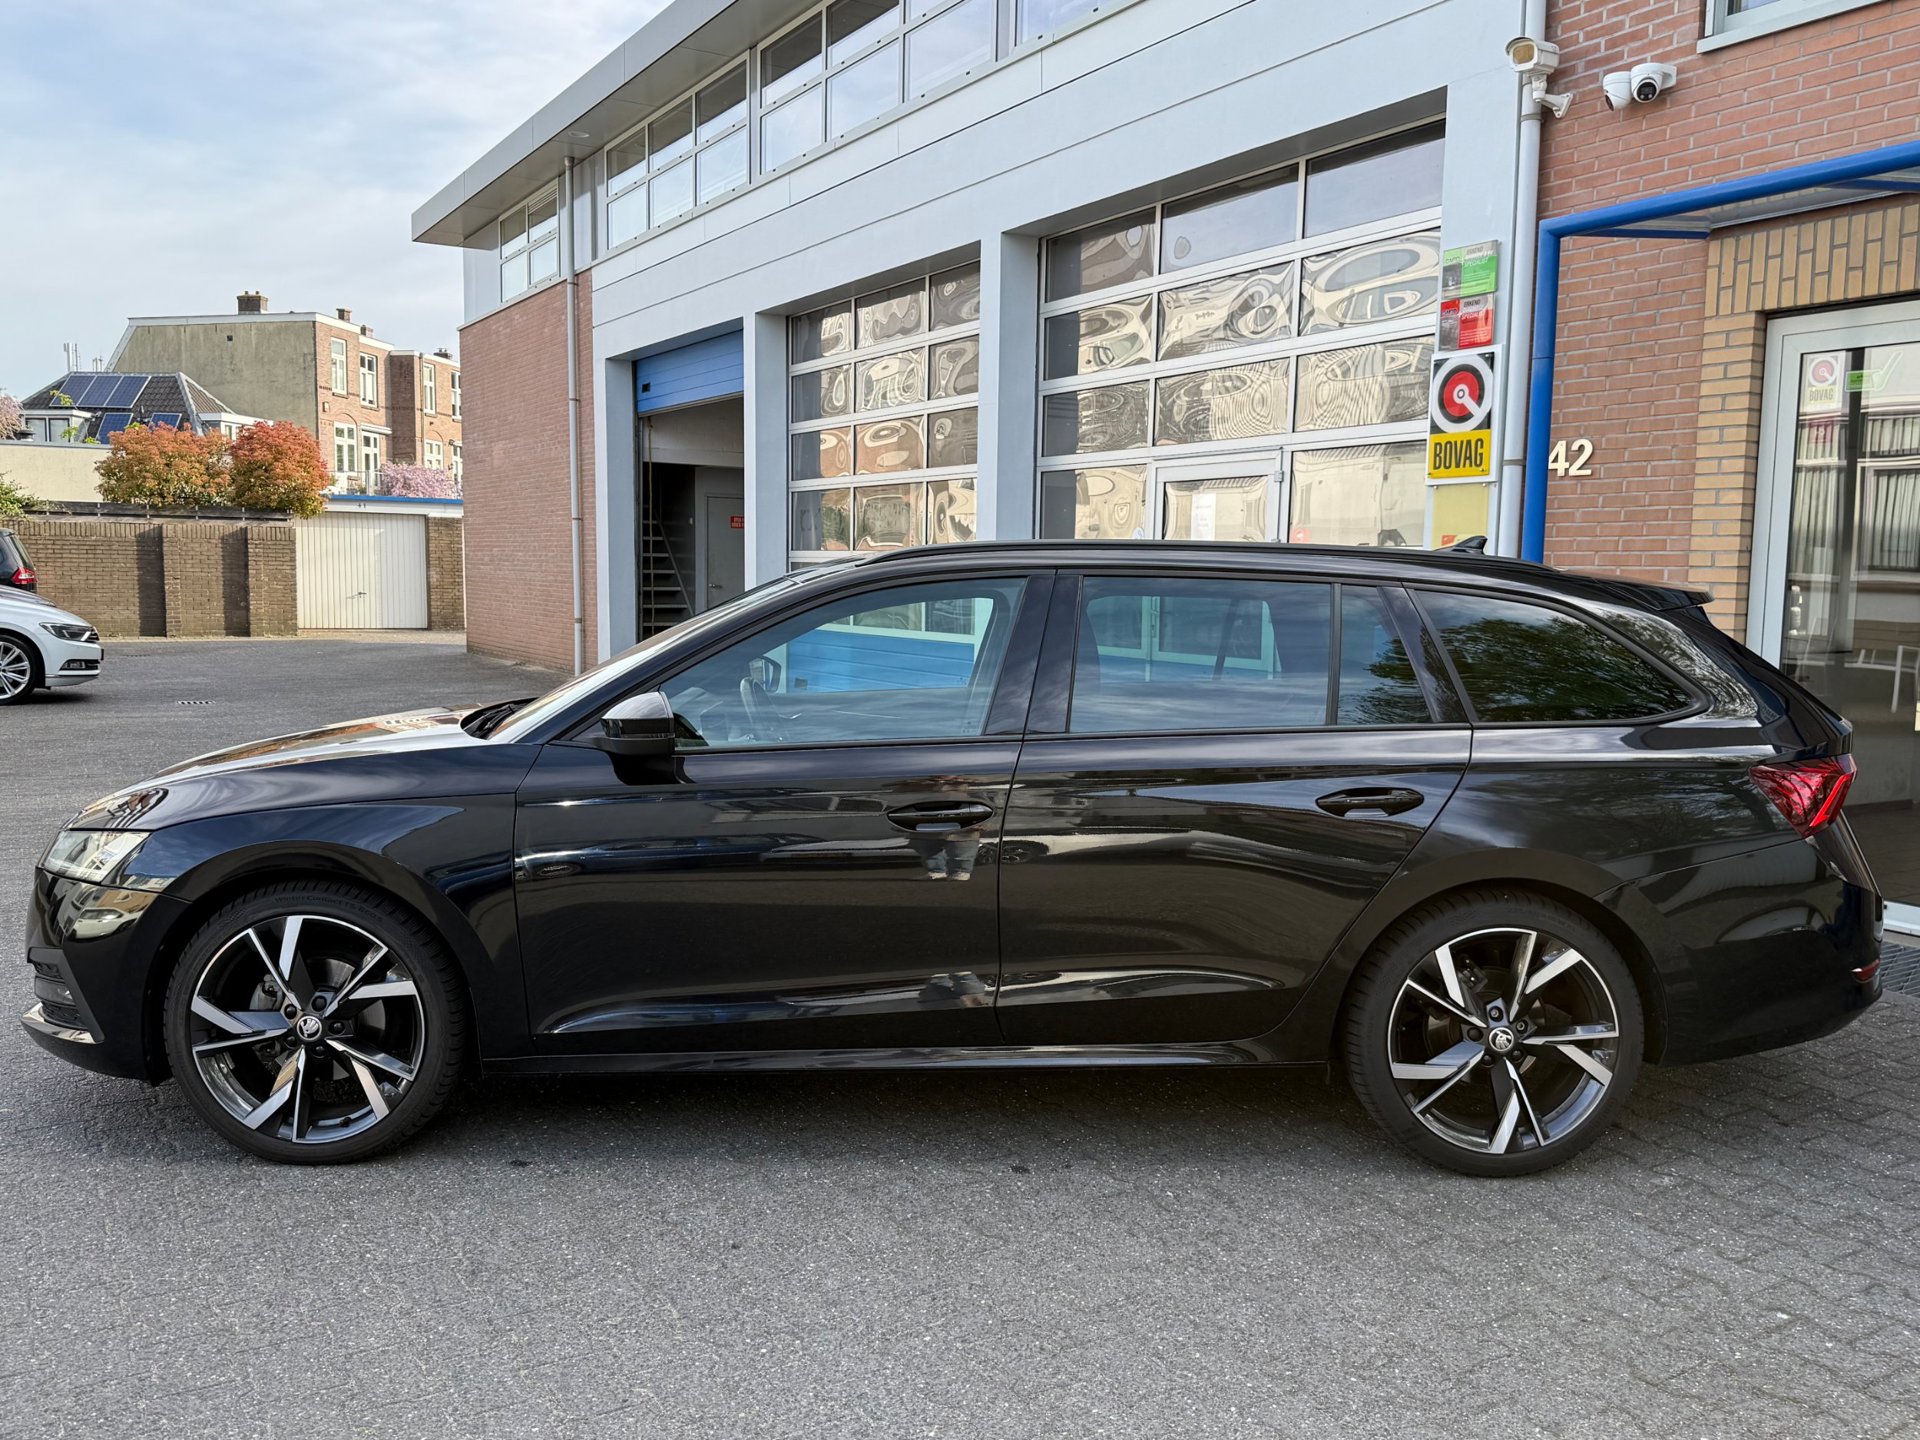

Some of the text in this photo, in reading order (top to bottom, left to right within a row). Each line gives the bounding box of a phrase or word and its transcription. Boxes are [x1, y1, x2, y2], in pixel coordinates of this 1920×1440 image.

[1809, 387, 1835, 402] BOVAG
[1433, 437, 1485, 471] BOVAG
[1548, 438, 1594, 477] 42
